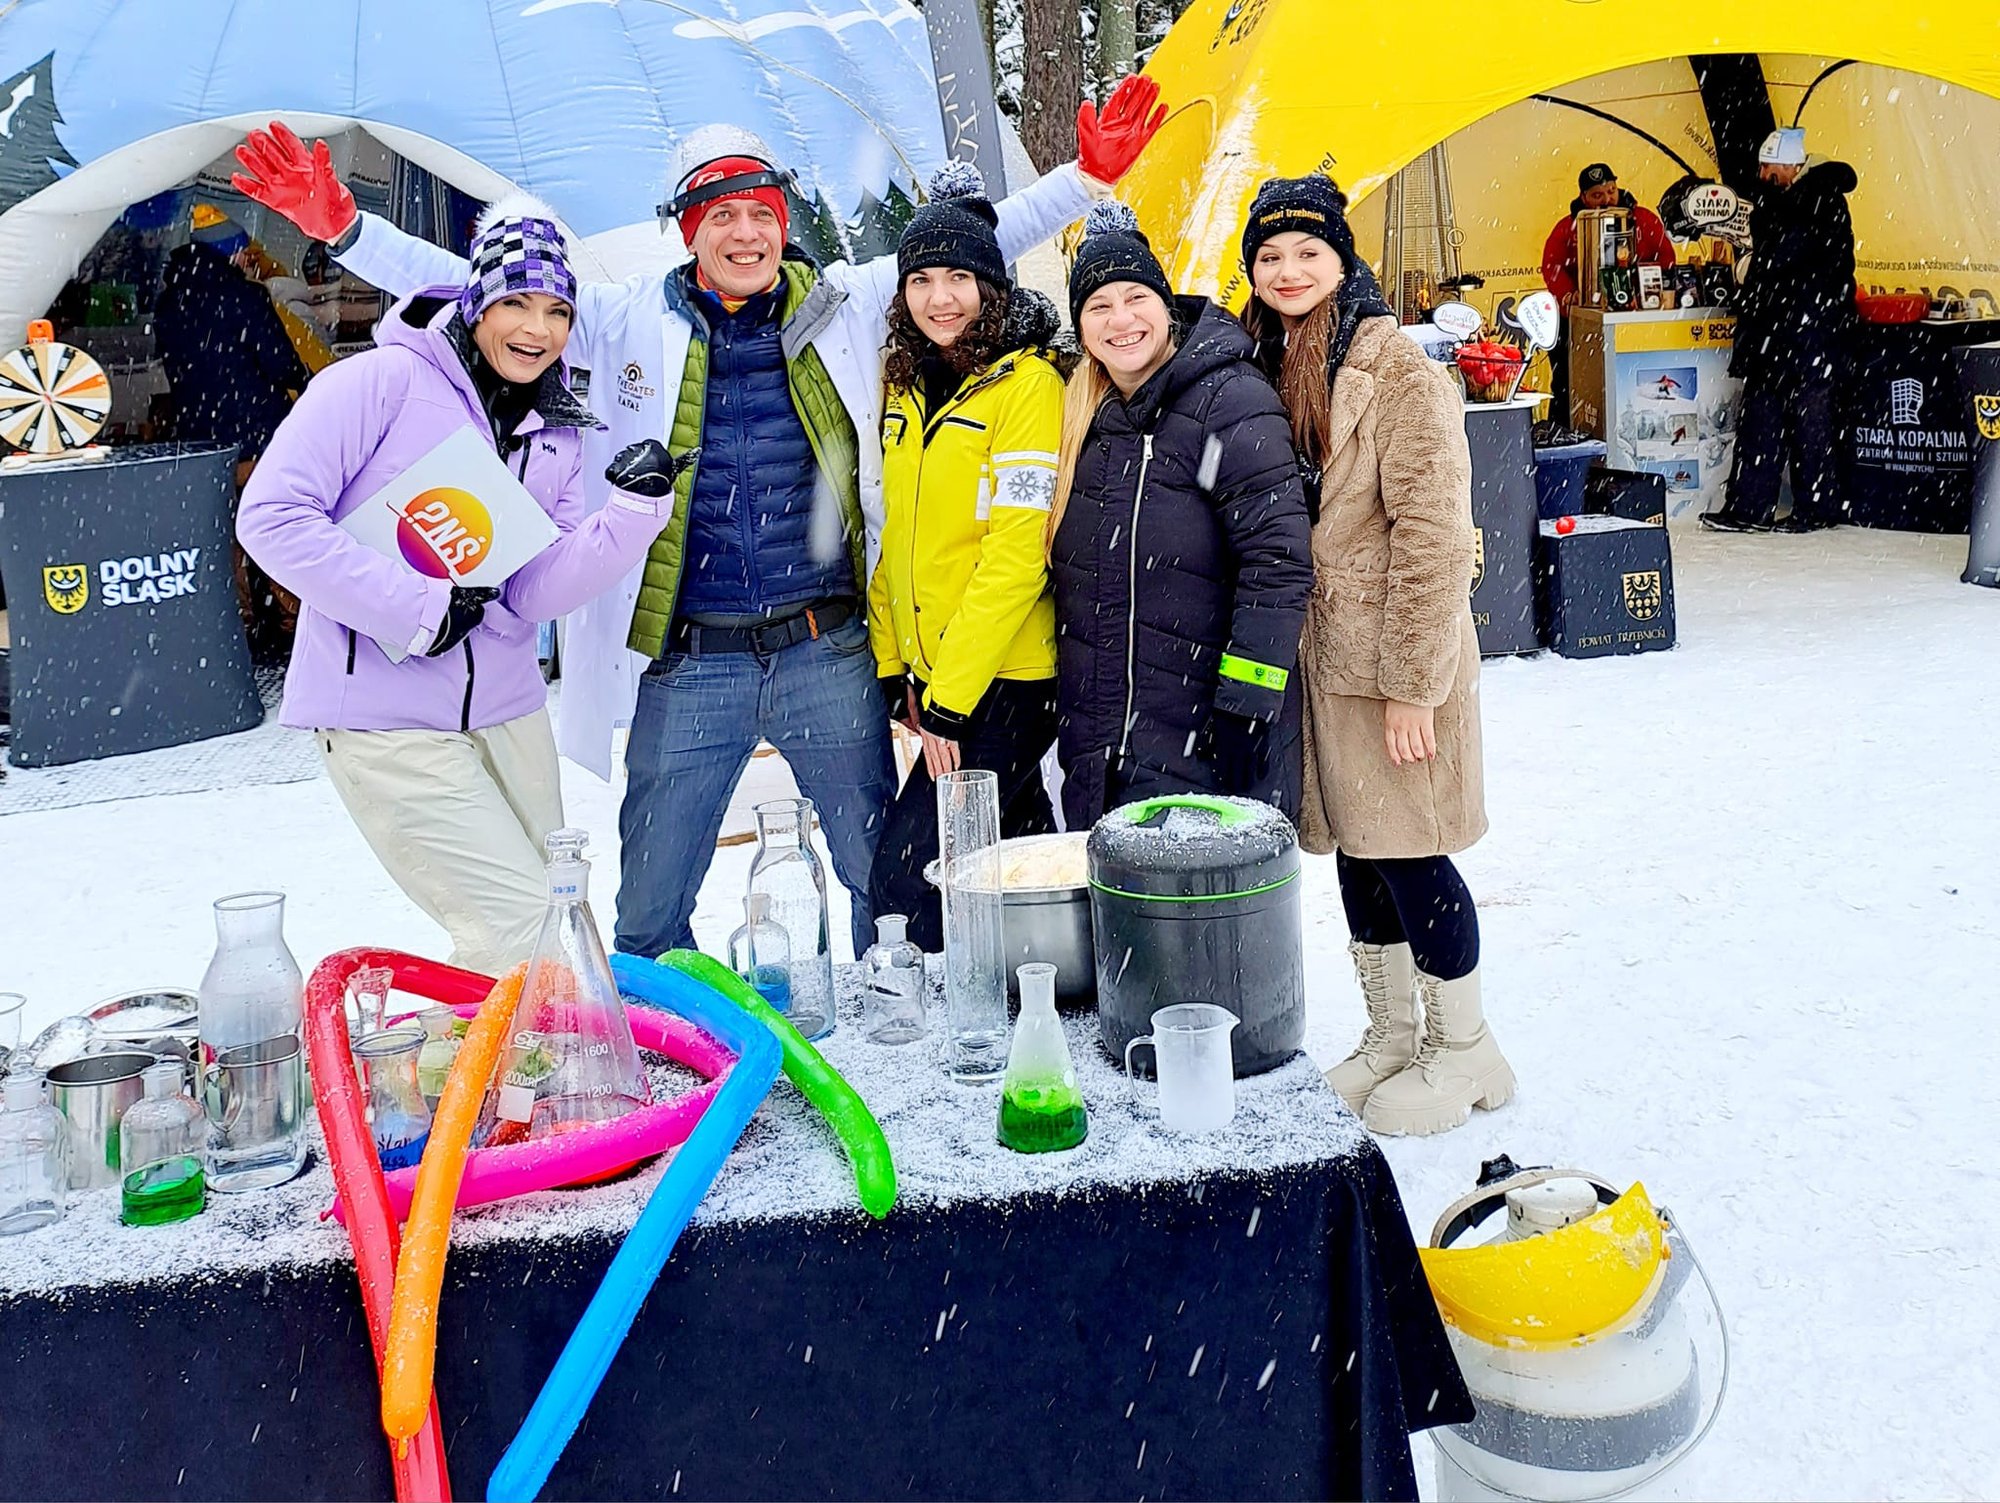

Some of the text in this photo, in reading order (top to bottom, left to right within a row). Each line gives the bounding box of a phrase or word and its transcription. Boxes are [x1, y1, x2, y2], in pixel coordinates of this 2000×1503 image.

[1856, 427, 1967, 448] STARA KOPALNIA
[1857, 447, 1968, 462] CENTRUM NAUKI I SZTUKI
[100, 548, 200, 584] DOLNY
[102, 572, 197, 606] ŚLĄSK
[1578, 629, 1667, 649] POWIAT TRZEBNICKI
[583, 1043, 608, 1057] 1600
[587, 1083, 612, 1098] 1200
